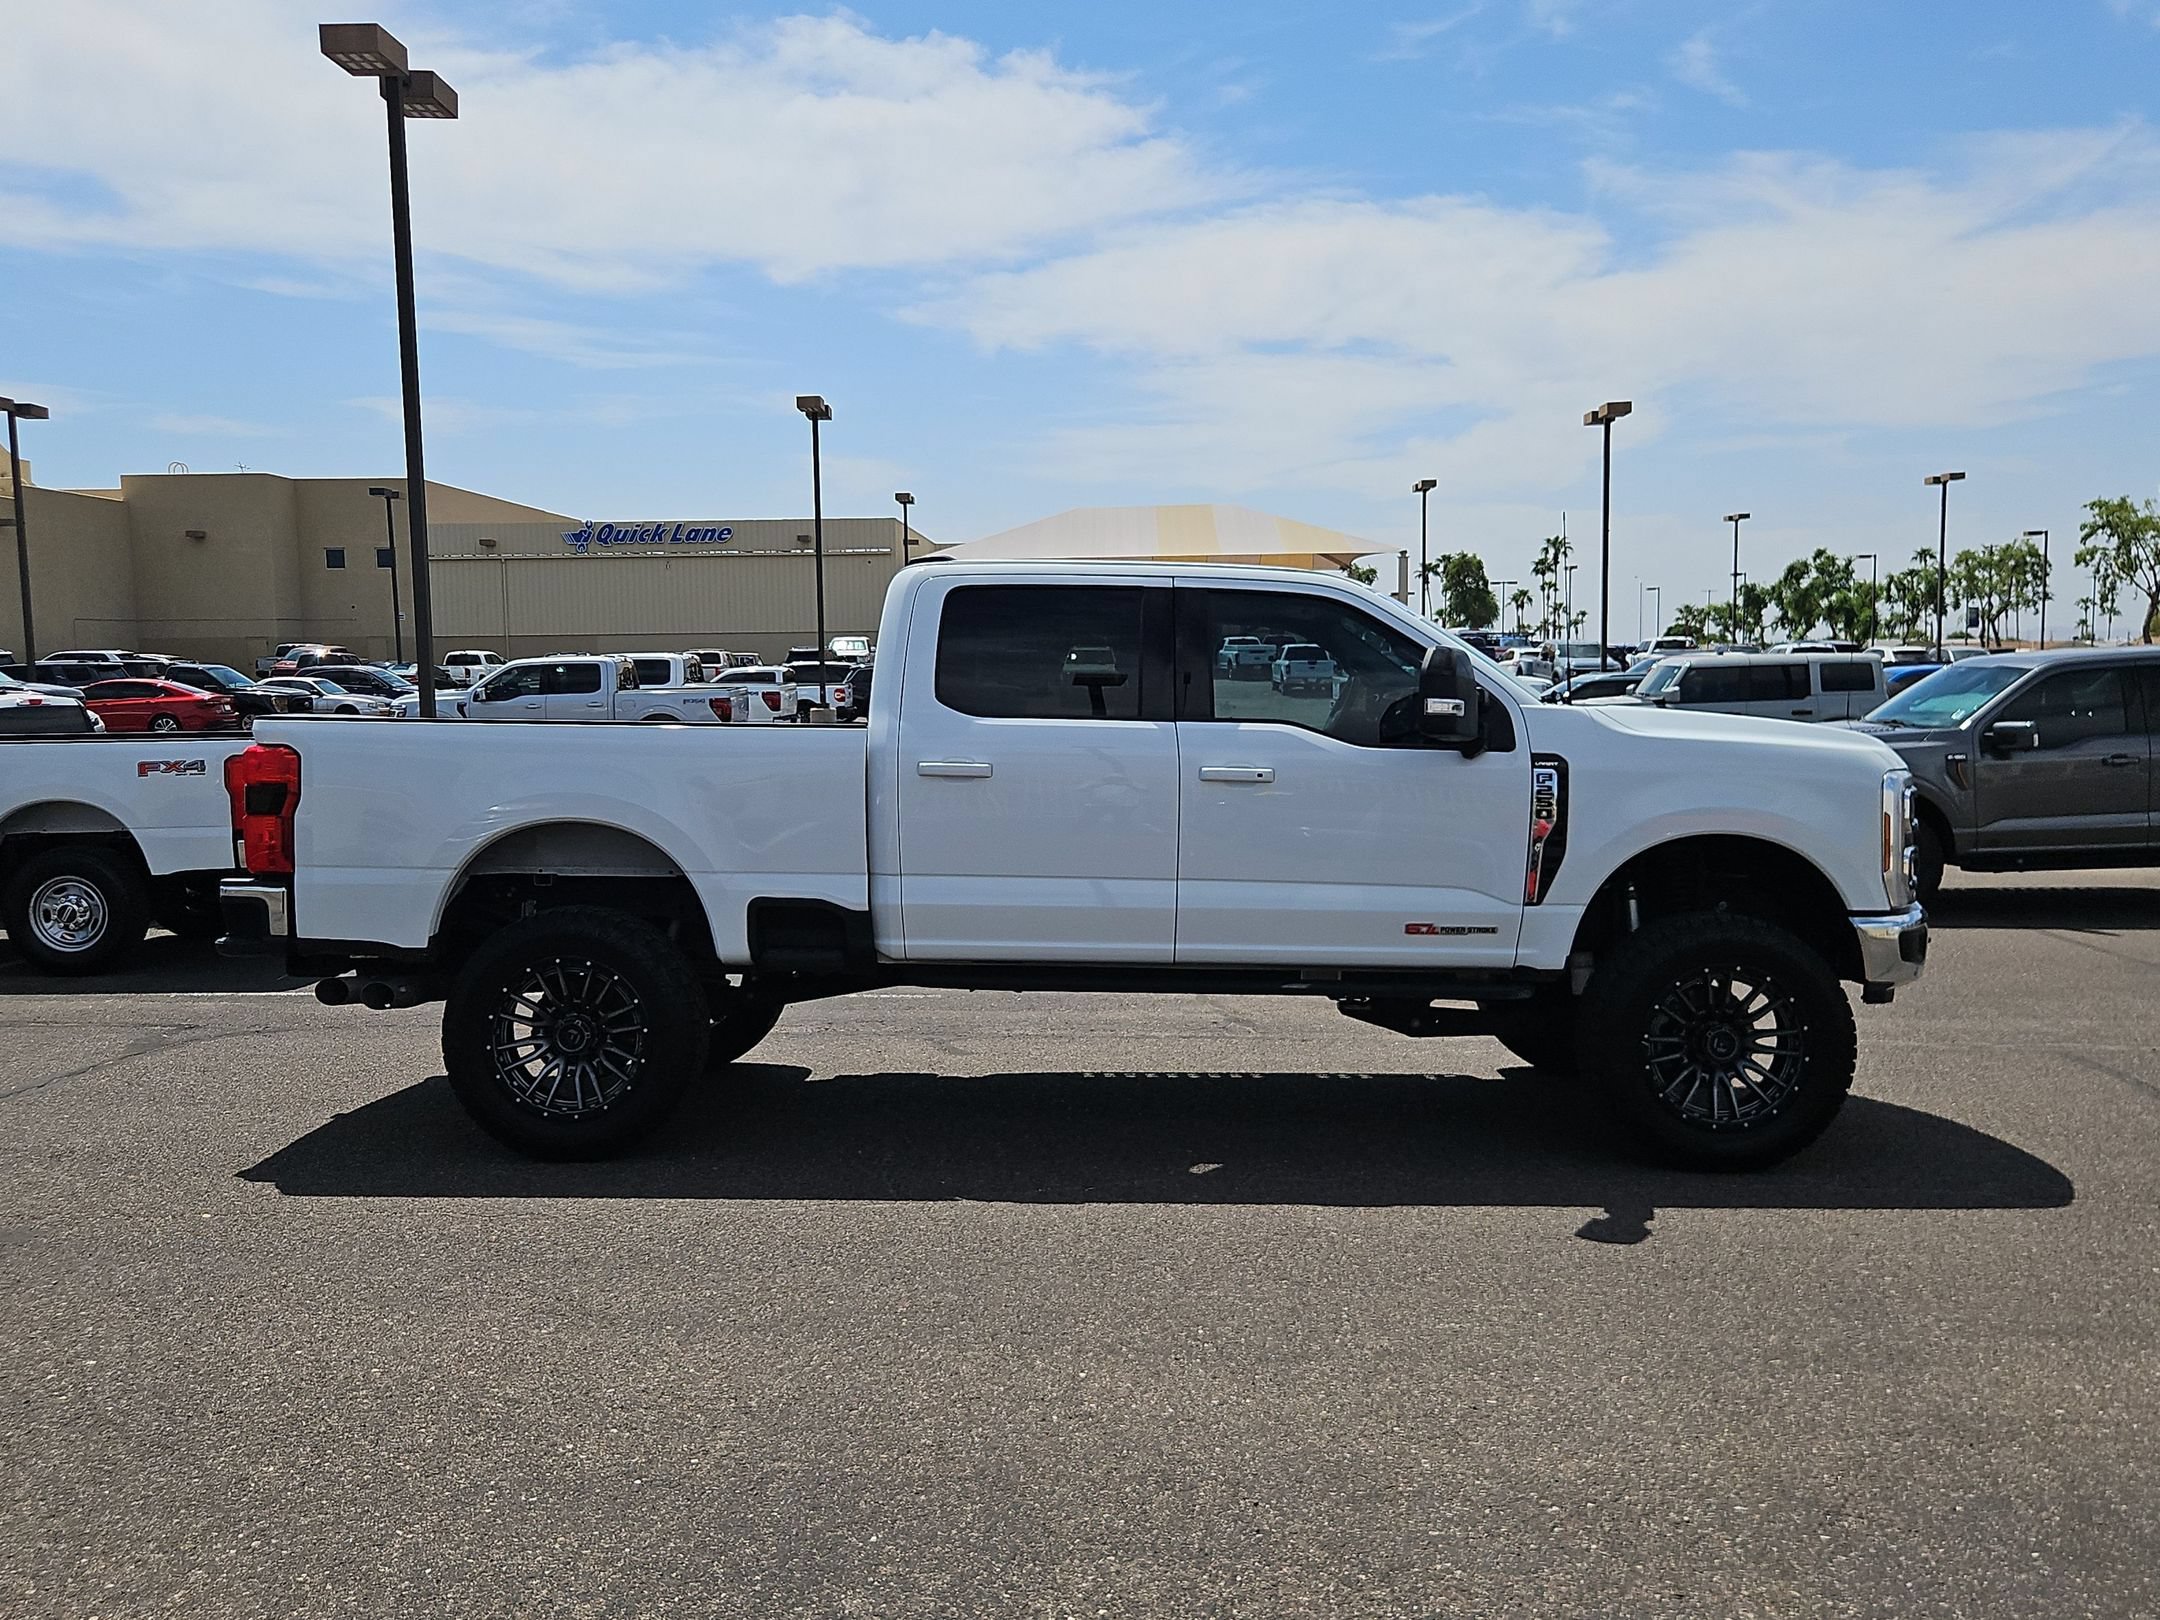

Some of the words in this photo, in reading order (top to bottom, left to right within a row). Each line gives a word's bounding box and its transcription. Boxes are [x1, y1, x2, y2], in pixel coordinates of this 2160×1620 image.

[595, 522, 669, 546] Quick
[668, 523, 733, 543] Lane
[137, 759, 206, 777] FX4
